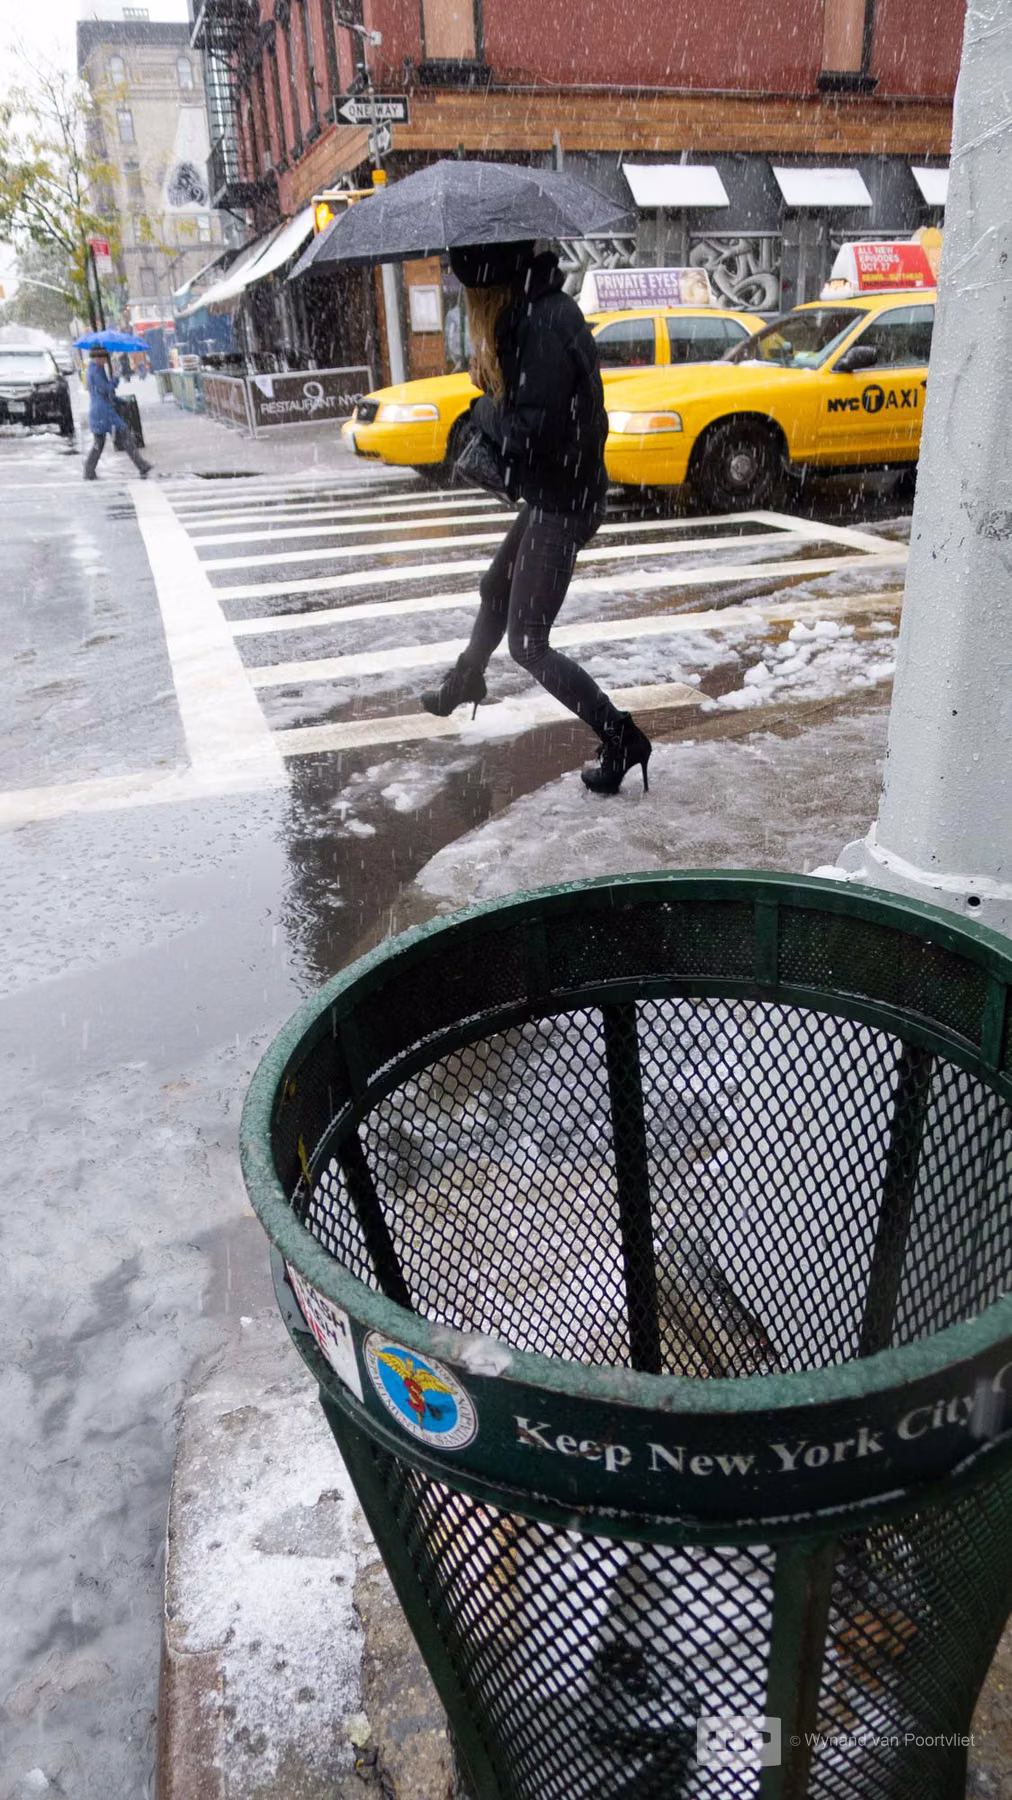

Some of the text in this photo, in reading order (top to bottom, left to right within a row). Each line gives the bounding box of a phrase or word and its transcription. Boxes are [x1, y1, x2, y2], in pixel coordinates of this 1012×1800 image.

[348, 104, 398, 117] ONE WAY
[857, 247, 894, 256] ALL NEW
[858, 255, 900, 264] EPISODES
[596, 273, 679, 289] PRIVATE EYES
[260, 396, 335, 414] RESTAURANT
[338, 393, 363, 407] NYC
[827, 397, 860, 412] NYC
[513, 1395, 976, 1476] Keep New York City
